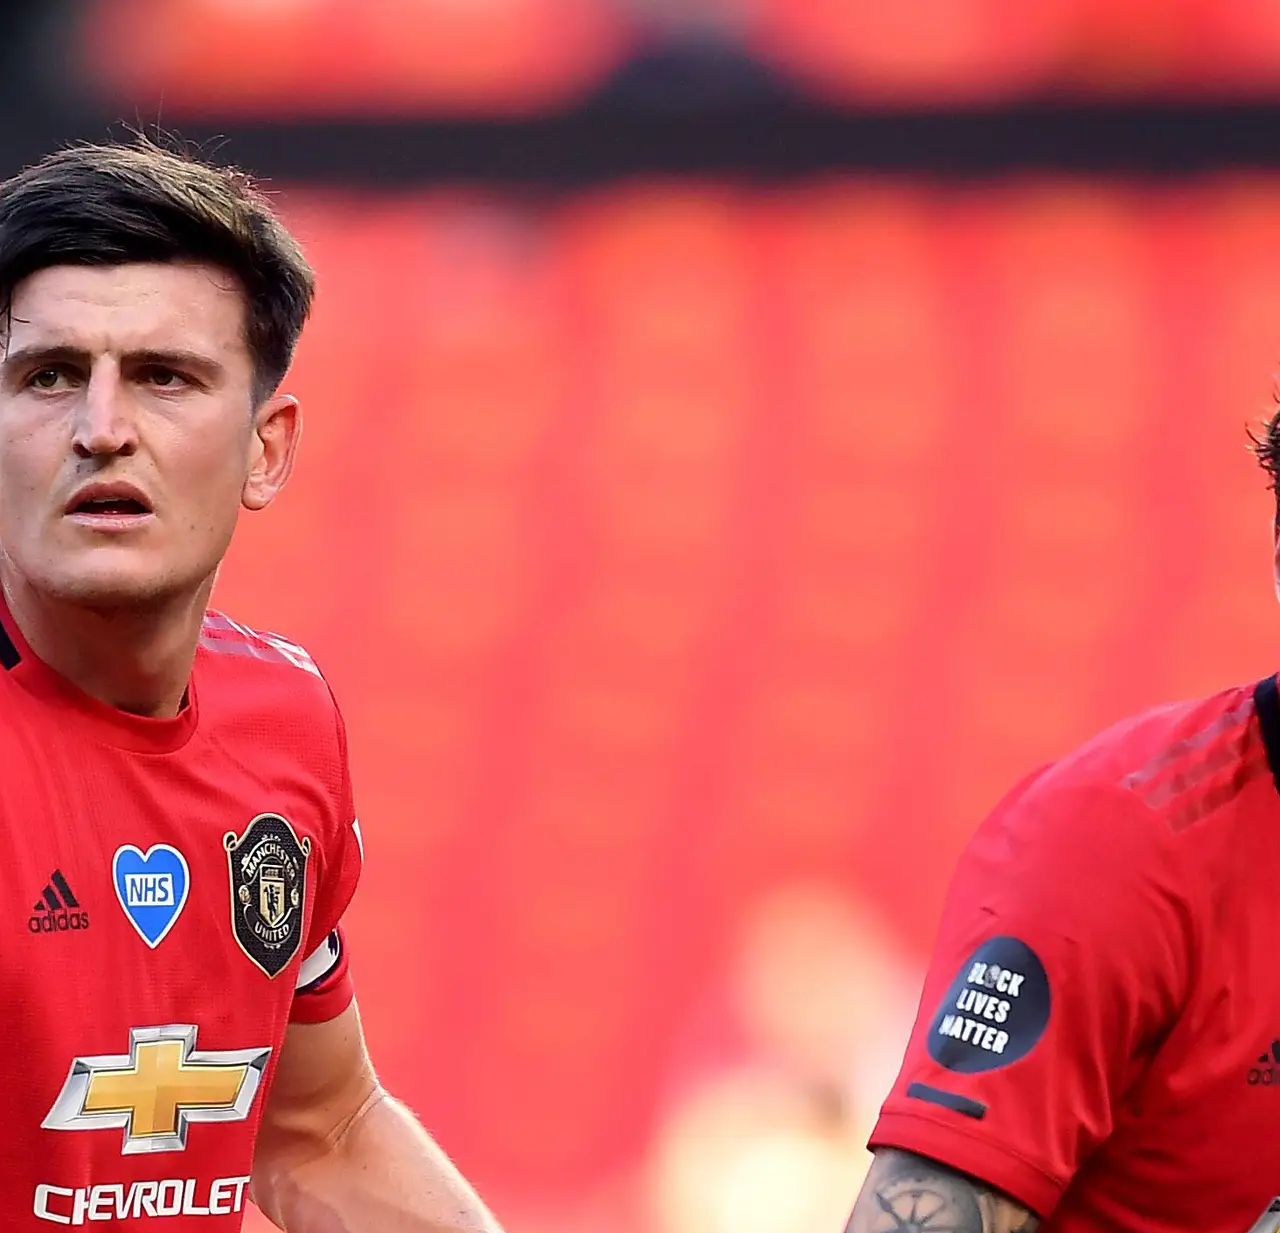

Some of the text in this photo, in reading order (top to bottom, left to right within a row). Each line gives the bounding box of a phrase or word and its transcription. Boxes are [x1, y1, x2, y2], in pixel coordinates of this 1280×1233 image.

[245, 842, 296, 880] MANCHESTER
[129, 876, 170, 902] NHS
[28, 909, 89, 933] adidas
[254, 921, 290, 942] UNITED
[956, 987, 1012, 1024] LIVES
[938, 1014, 1010, 1055] MATTER
[33, 1175, 251, 1226] CHEVROLET
